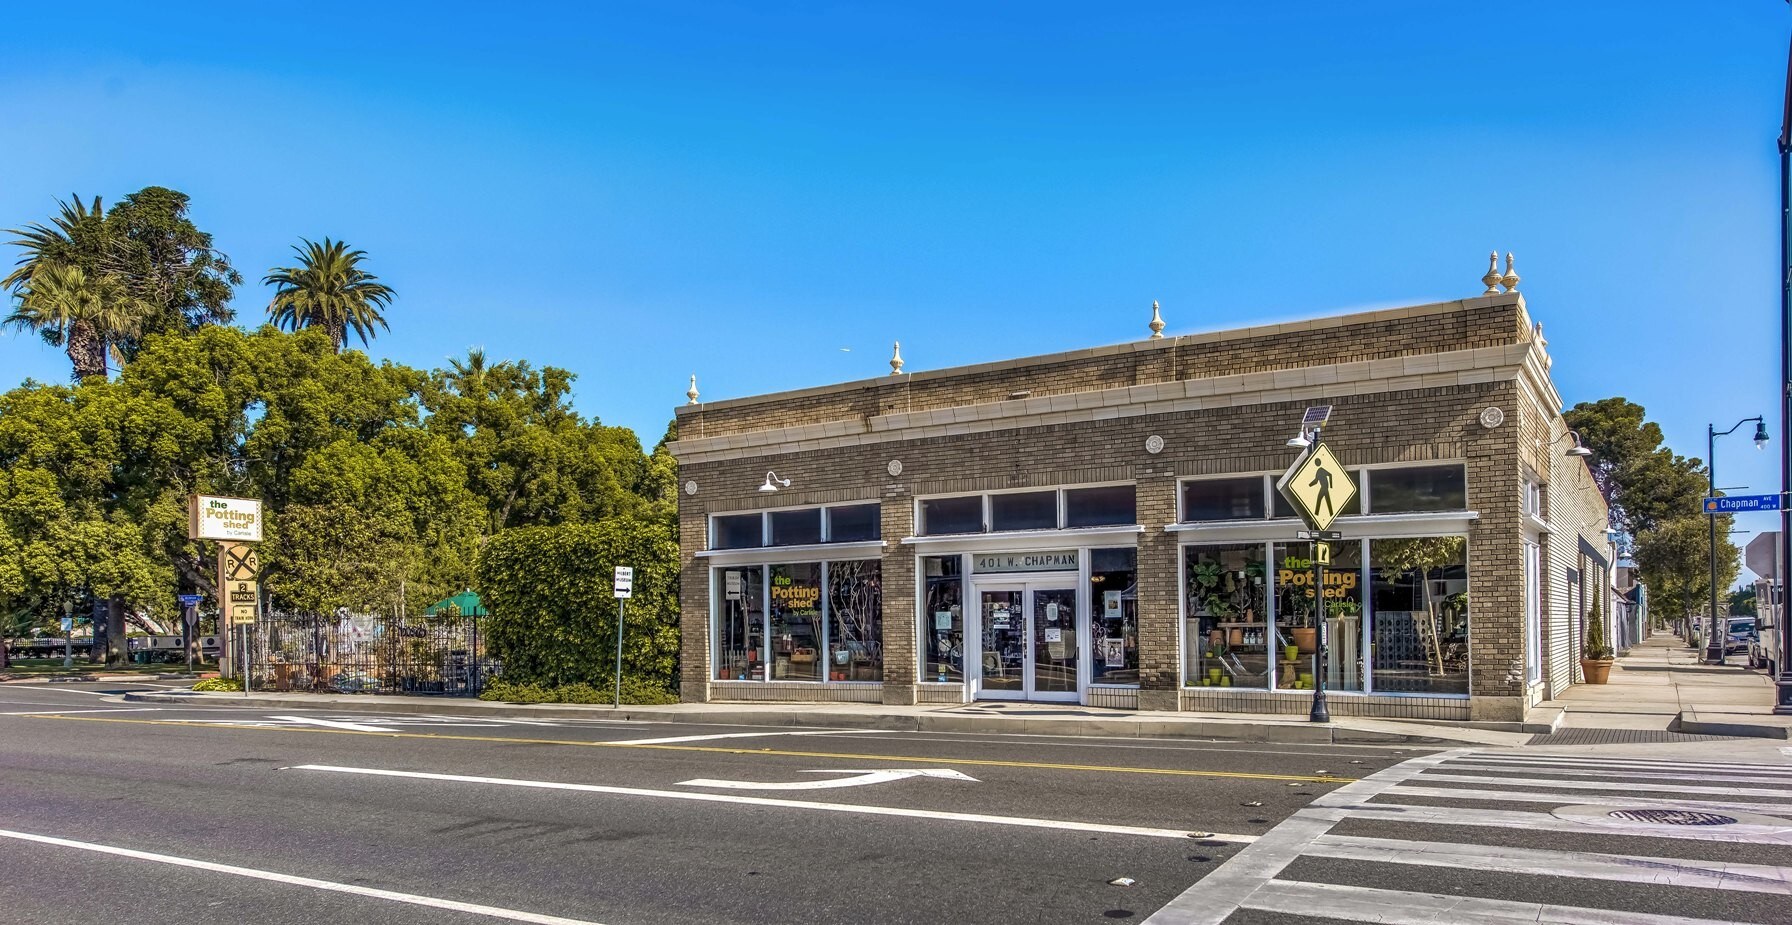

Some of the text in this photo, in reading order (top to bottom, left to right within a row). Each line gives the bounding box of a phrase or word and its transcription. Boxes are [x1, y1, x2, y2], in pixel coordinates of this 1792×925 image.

[210, 500, 228, 509] the
[1720, 499, 1758, 509] Chapman
[206, 508, 255, 524] Potting
[223, 520, 249, 529] shed
[228, 557, 256, 569] R R
[980, 554, 1076, 568] 401 W. CHAPMAN
[1284, 556, 1311, 569] the
[774, 576, 791, 585] the
[1278, 569, 1356, 589] Poting
[240, 584, 246, 592] 2
[771, 586, 819, 601] Potting
[1305, 585, 1346, 598] sed
[232, 593, 255, 601] TRACKS
[788, 599, 813, 608] shed
